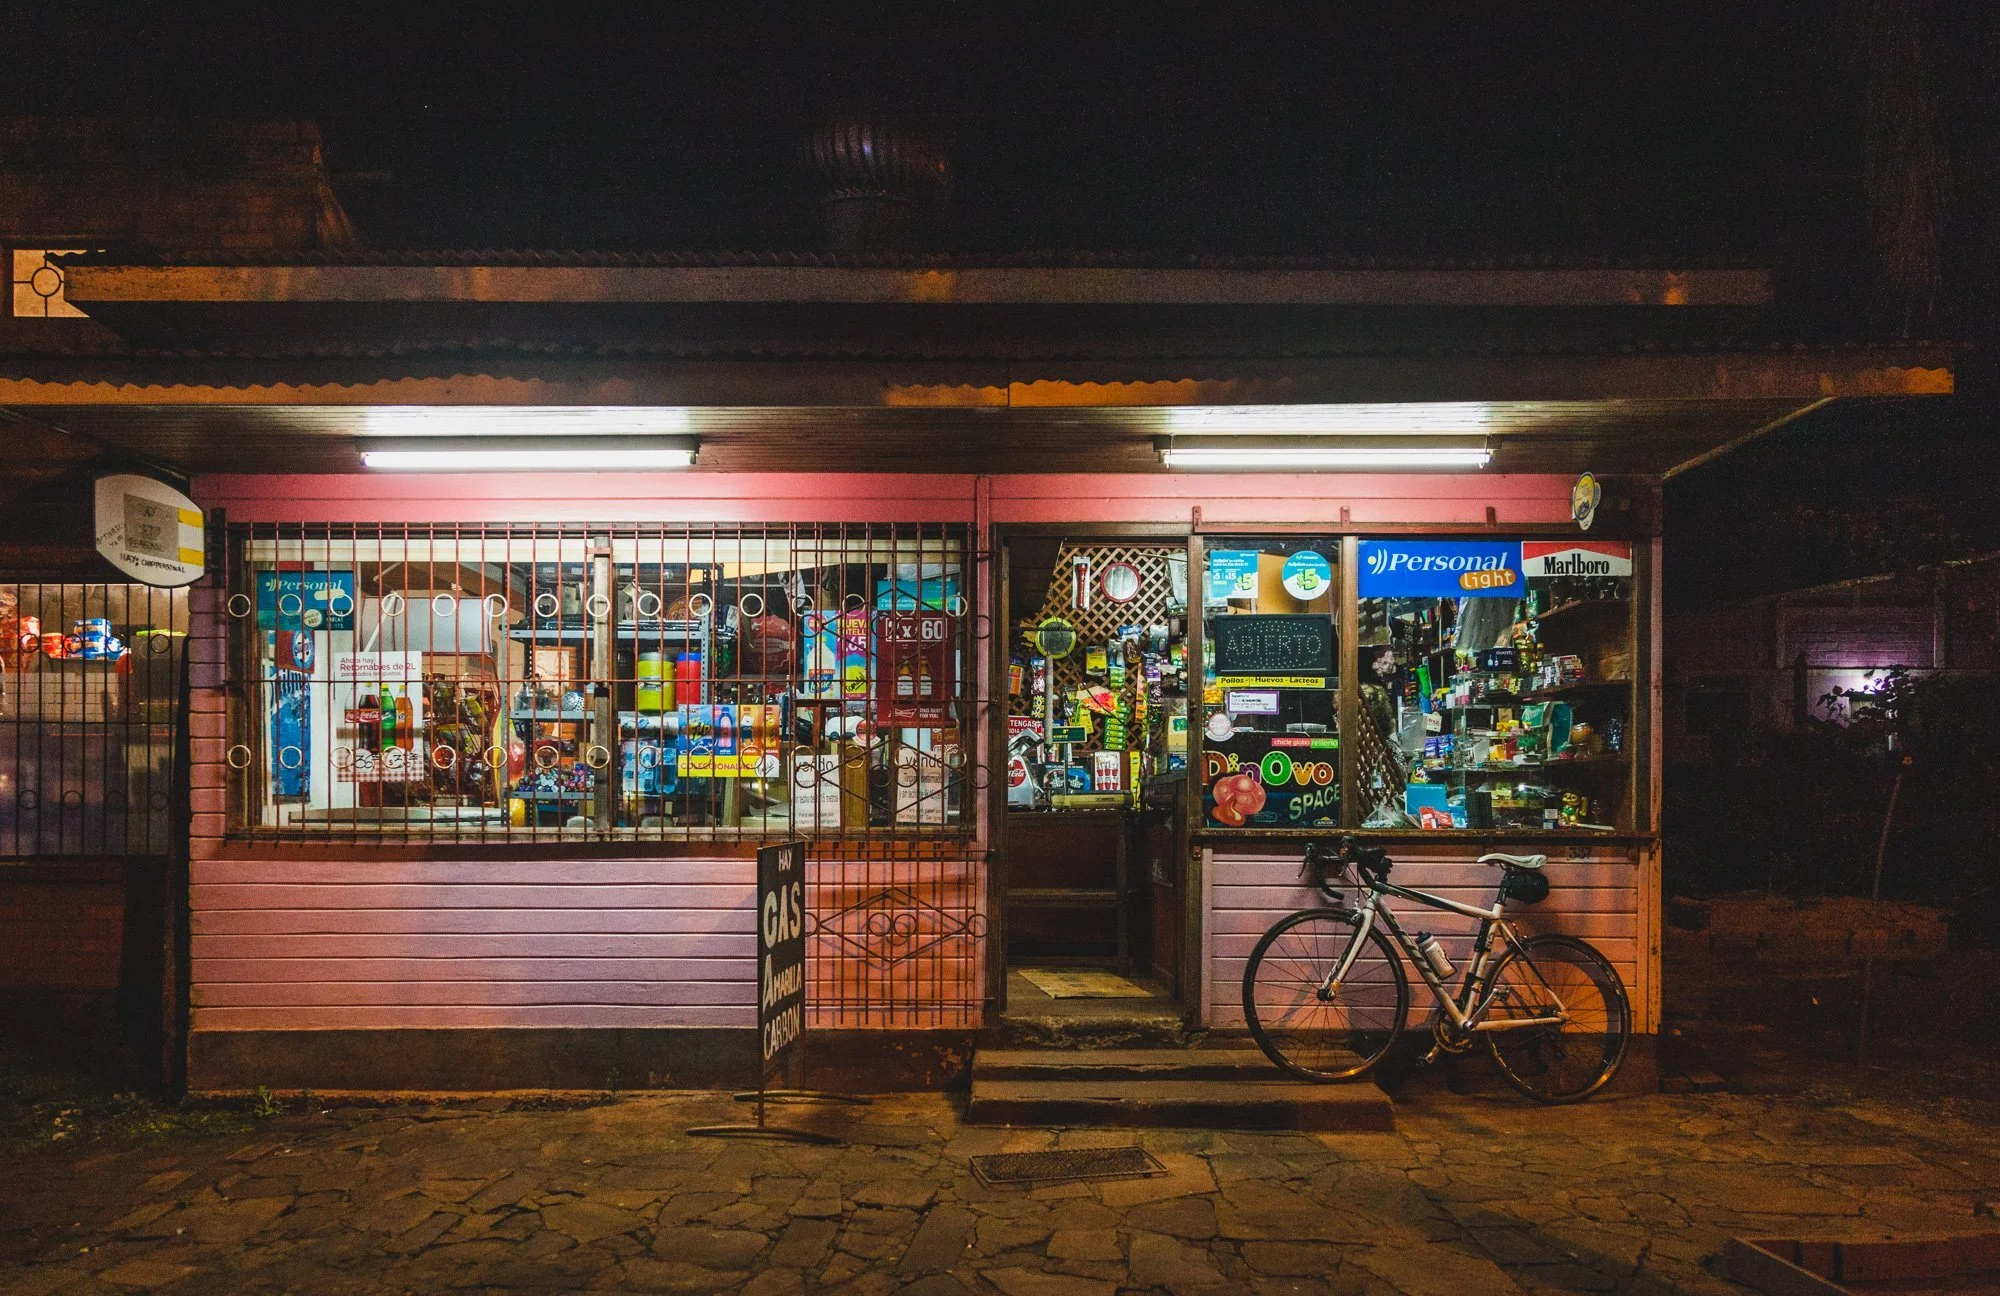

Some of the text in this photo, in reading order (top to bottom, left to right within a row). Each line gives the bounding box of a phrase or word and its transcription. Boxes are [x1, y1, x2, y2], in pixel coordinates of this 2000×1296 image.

[1388, 552, 1508, 571] Personal
[1543, 554, 1610, 575] Marlboro
[1237, 572, 1253, 590] $5
[1297, 568, 1319, 591] $5
[1463, 571, 1513, 589] light
[1225, 635, 1321, 655] ABIERTO
[340, 663, 391, 671] Retornabes
[1289, 676, 1319, 684] Lacteos
[1010, 719, 1036, 727] TENGAS
[1273, 738, 1292, 746] chicle
[1292, 739, 1310, 747] globo
[1201, 750, 1334, 786] DinOvo
[1288, 783, 1340, 821] SPACE
[778, 848, 793, 872] HAY
[762, 953, 802, 1014] AMARILLA
[763, 1003, 801, 1061] CARBON
